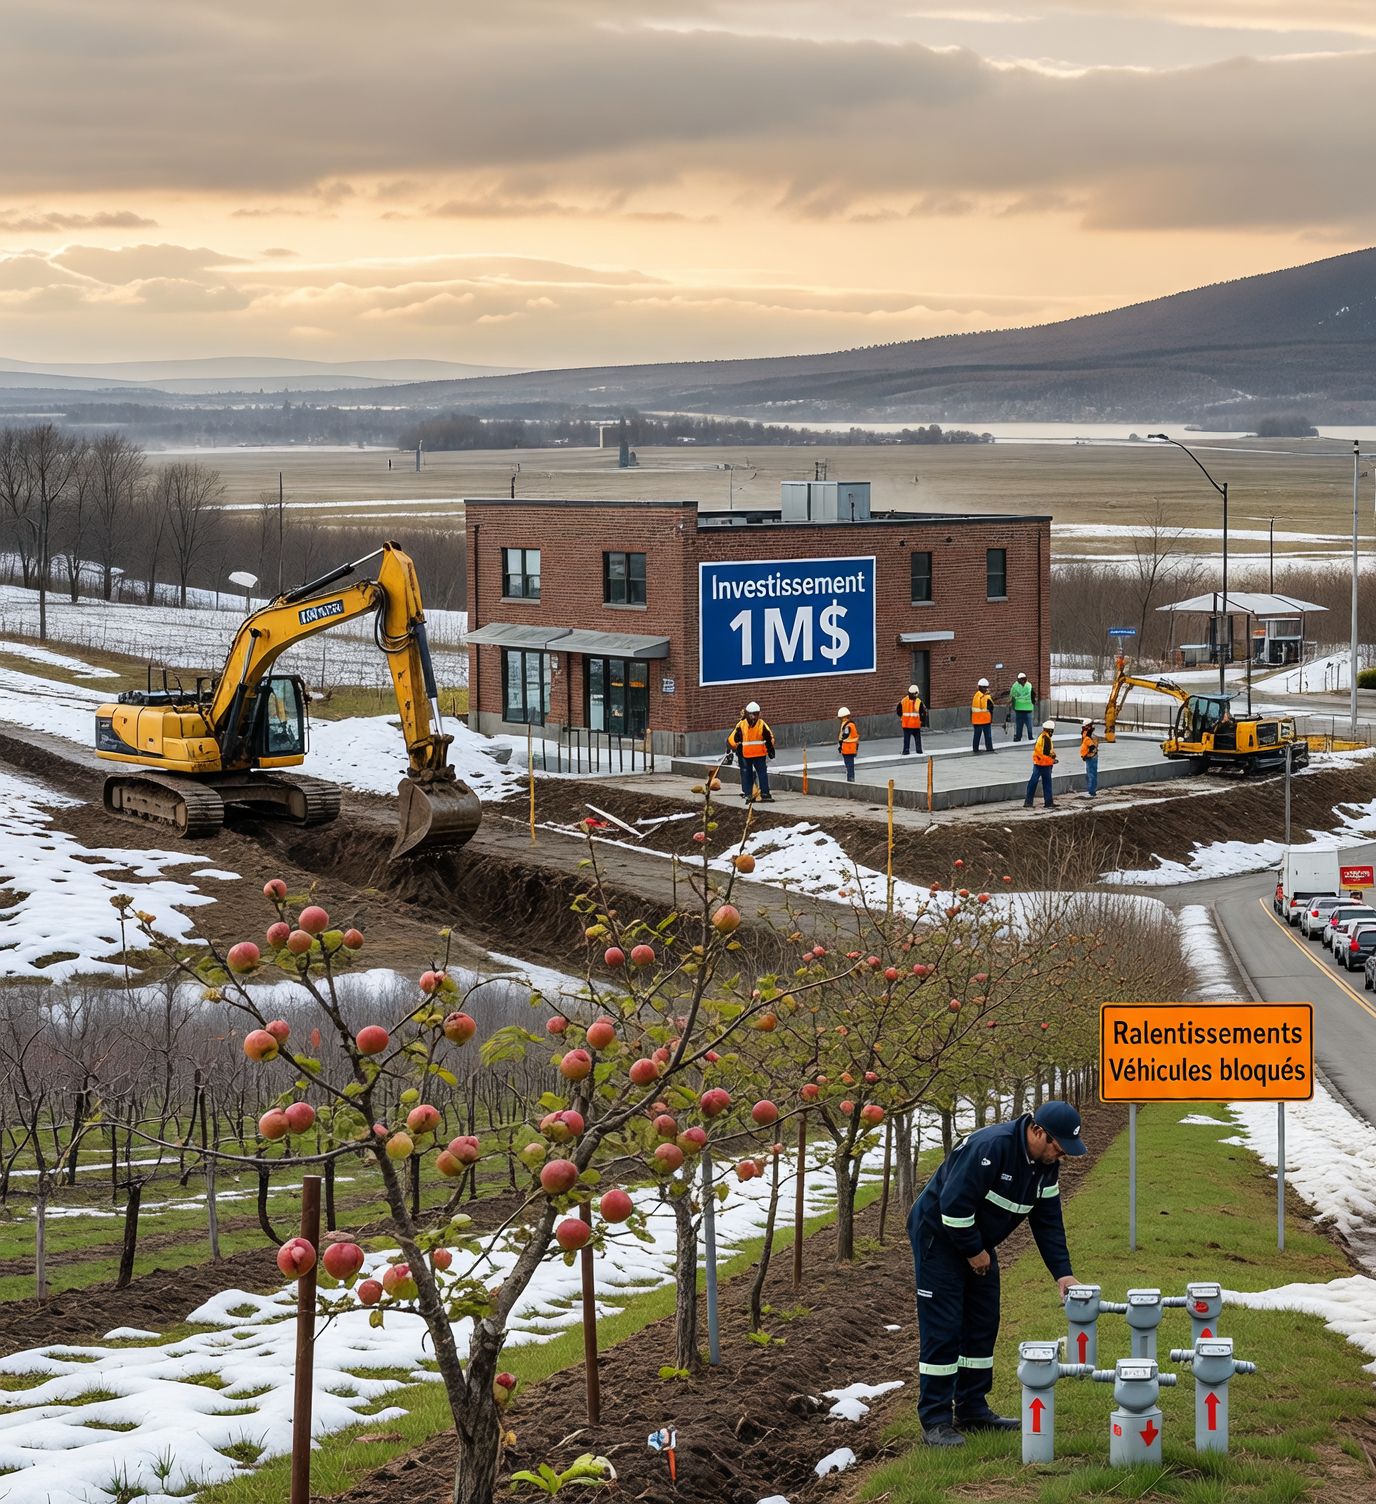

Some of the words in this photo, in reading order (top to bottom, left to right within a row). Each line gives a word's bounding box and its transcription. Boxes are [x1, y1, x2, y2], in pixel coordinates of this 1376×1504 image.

[712, 571, 865, 600] Investissement
[729, 599, 850, 666] 1M$
[1113, 1020, 1303, 1045] Ralentissements
[1109, 1057, 1212, 1082] Véhicules
[1220, 1057, 1306, 1087] bloqués
